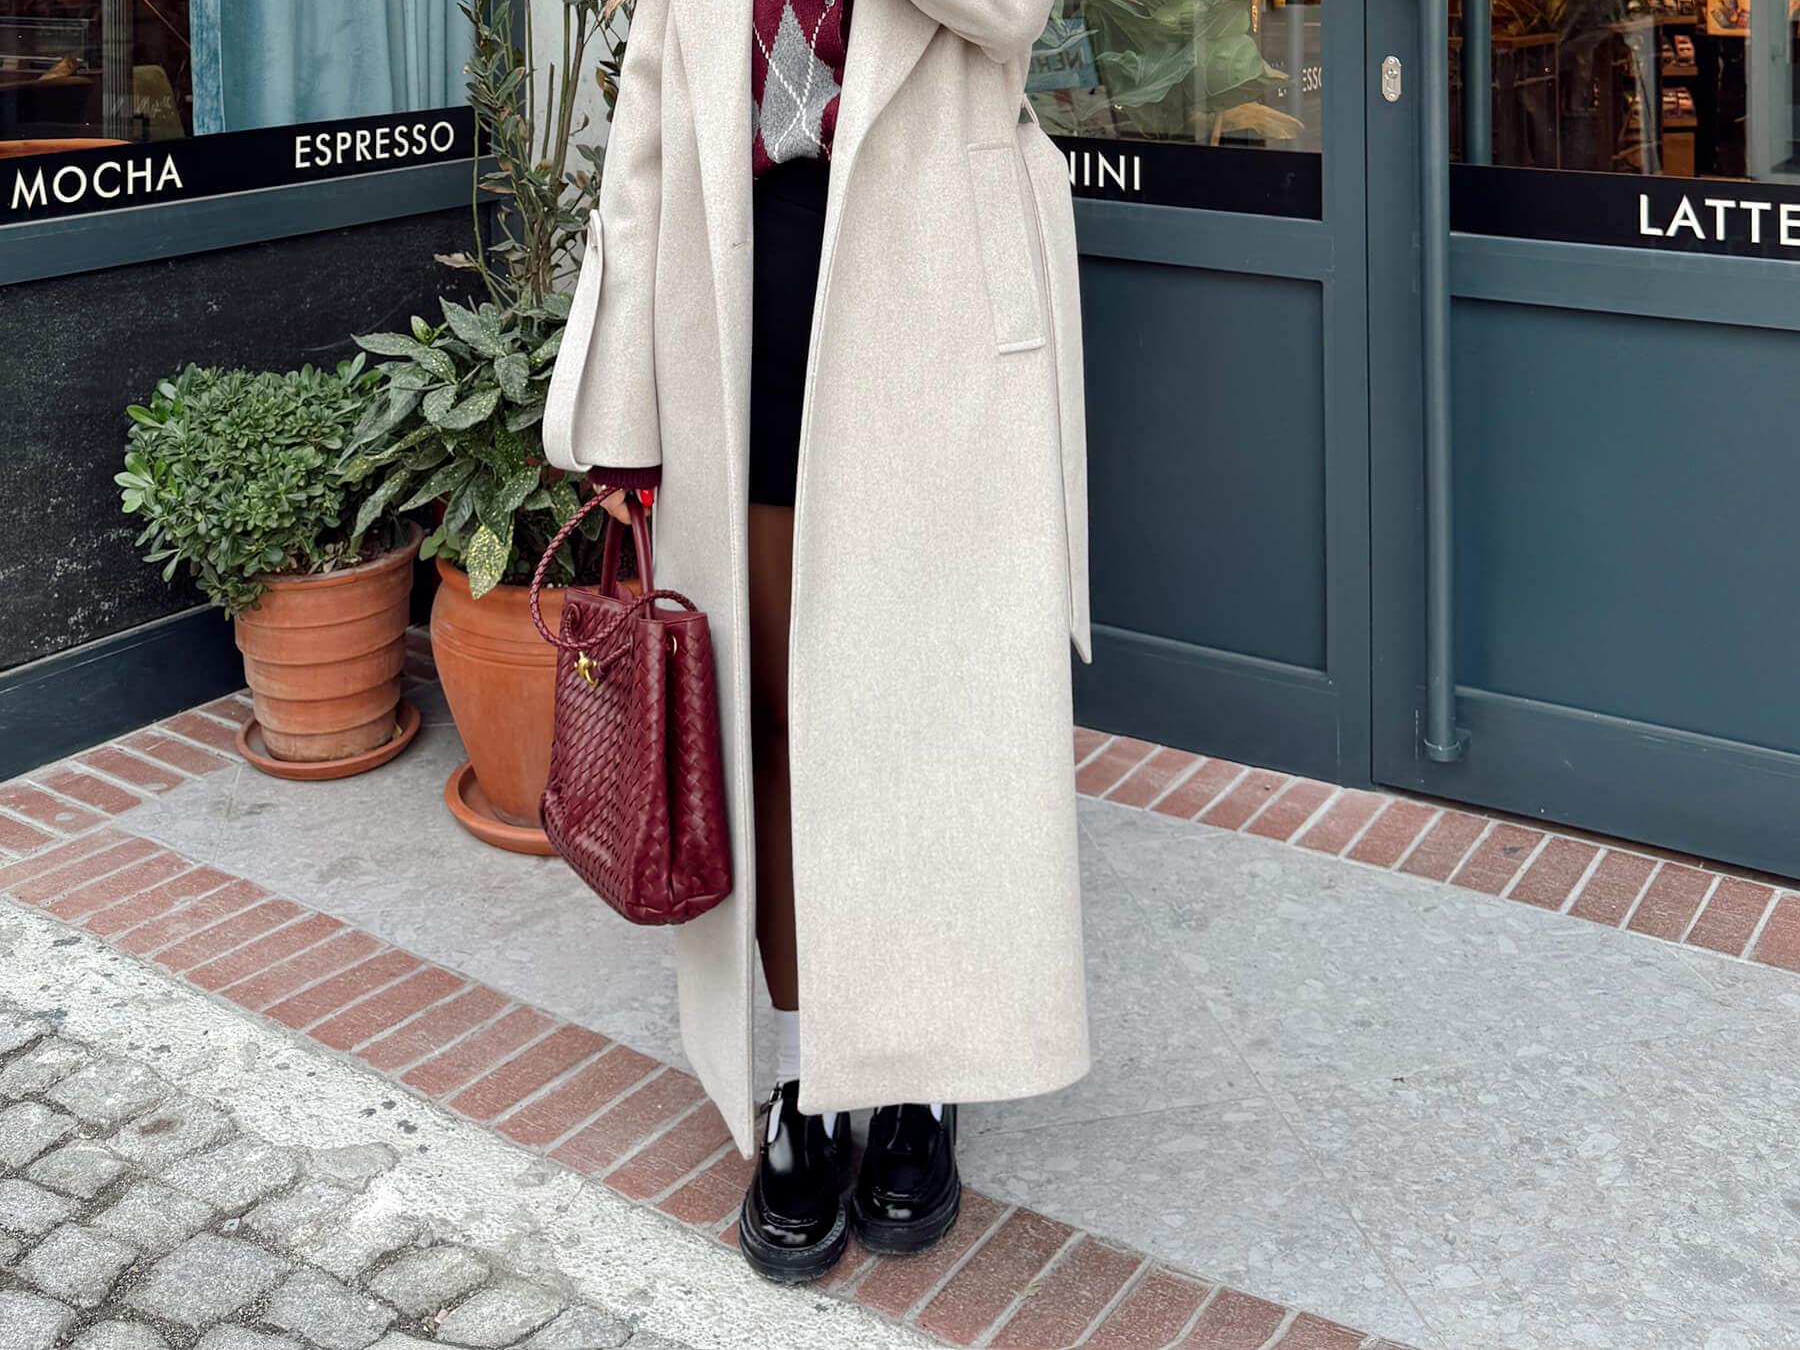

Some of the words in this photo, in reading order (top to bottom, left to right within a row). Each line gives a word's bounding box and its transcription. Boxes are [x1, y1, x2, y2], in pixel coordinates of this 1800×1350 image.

[294, 121, 455, 168] ESPRESSO
[10, 153, 183, 210] MOCHA
[1639, 194, 1800, 246] LATTE
